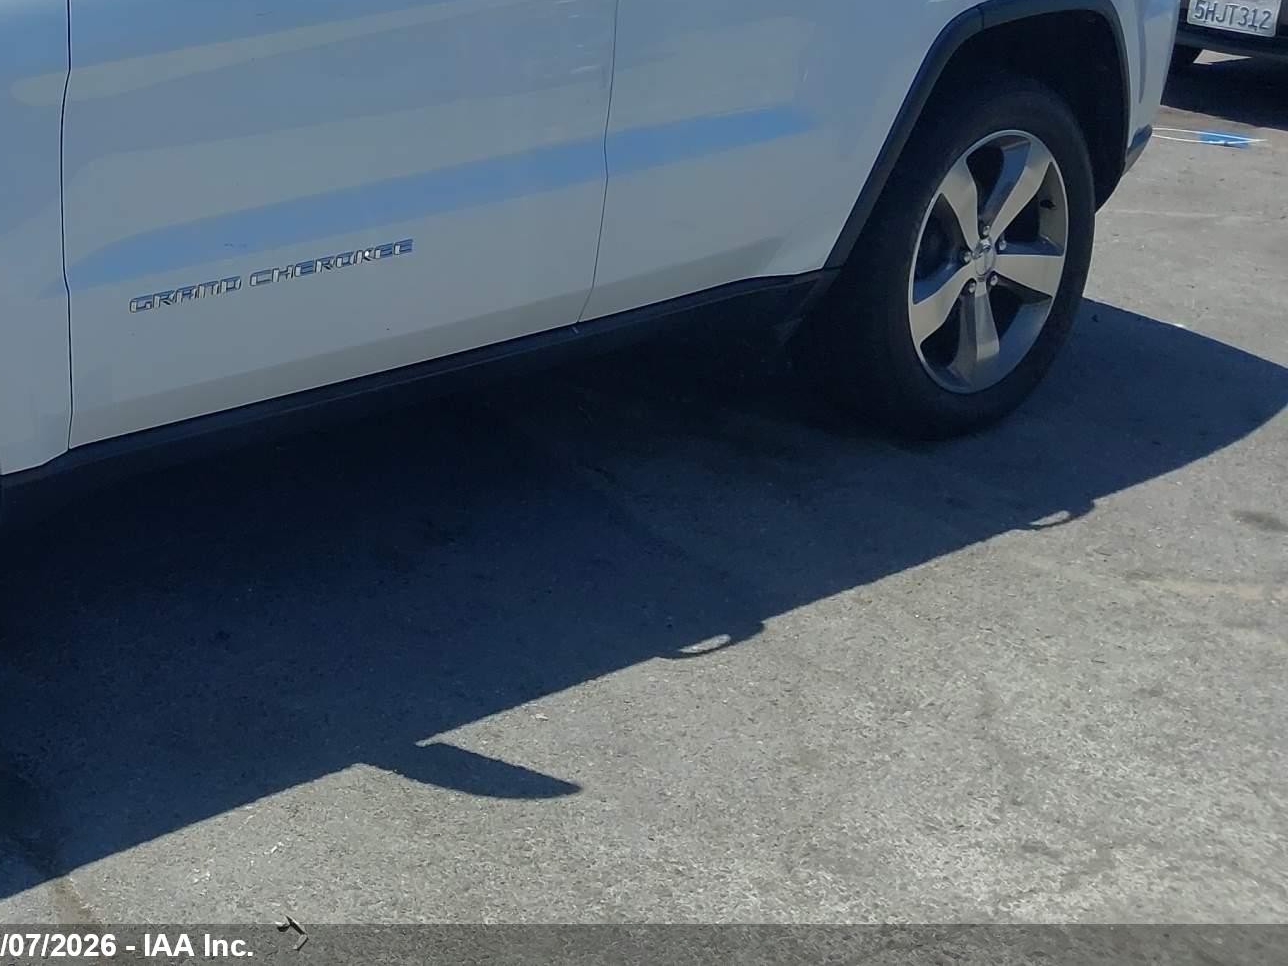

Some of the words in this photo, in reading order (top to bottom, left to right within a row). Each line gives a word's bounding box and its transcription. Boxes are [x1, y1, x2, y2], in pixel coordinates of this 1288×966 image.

[1194, 0, 1272, 30] 5HJT312
[129, 276, 242, 314] GRAND
[249, 238, 414, 288] CHEROKEE
